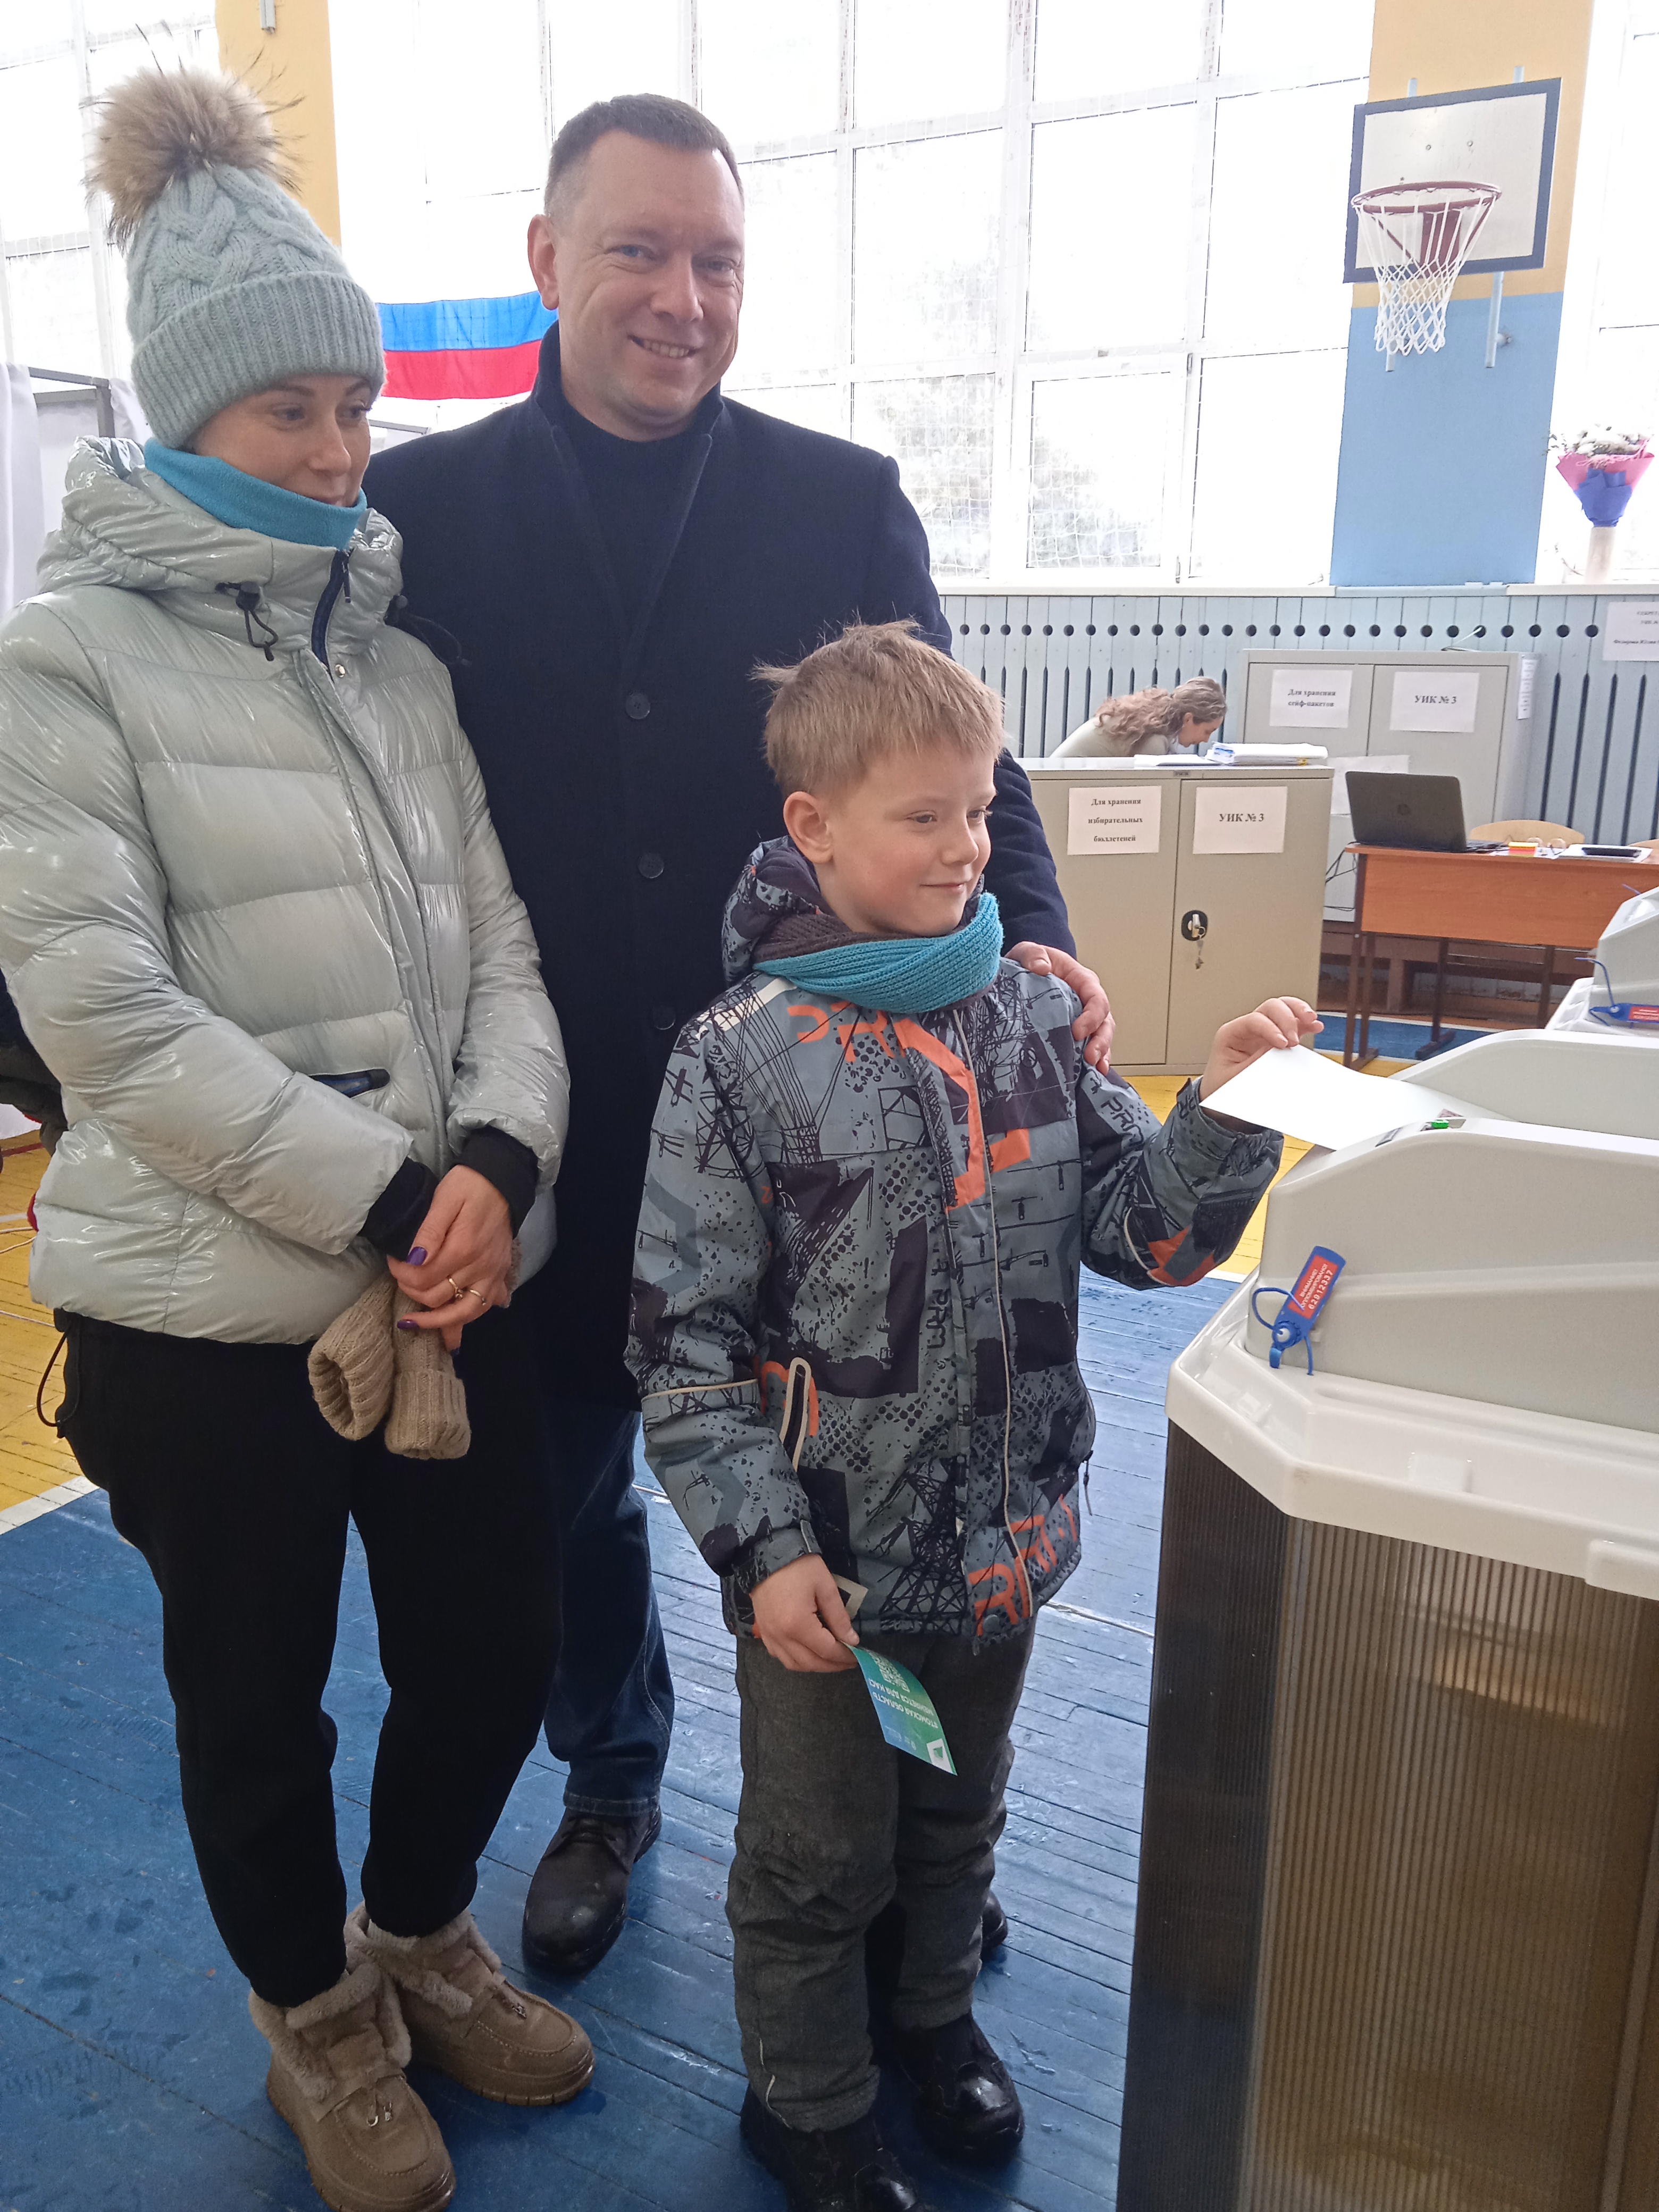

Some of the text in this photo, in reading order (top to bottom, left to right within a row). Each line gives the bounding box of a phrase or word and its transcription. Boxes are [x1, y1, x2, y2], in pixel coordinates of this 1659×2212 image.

[1414, 695, 1437, 703] УИК
[1088, 817, 1143, 825] избирательных
[1219, 813, 1264, 822] УИК № 3
[1299, 1268, 1318, 1297] ВНИМАНИЕ!
[1308, 1269, 1334, 1310] 62912337
[885, 1687, 900, 1699] ДЛЯ
[873, 1691, 904, 1712] ОБЛАСТЬ
